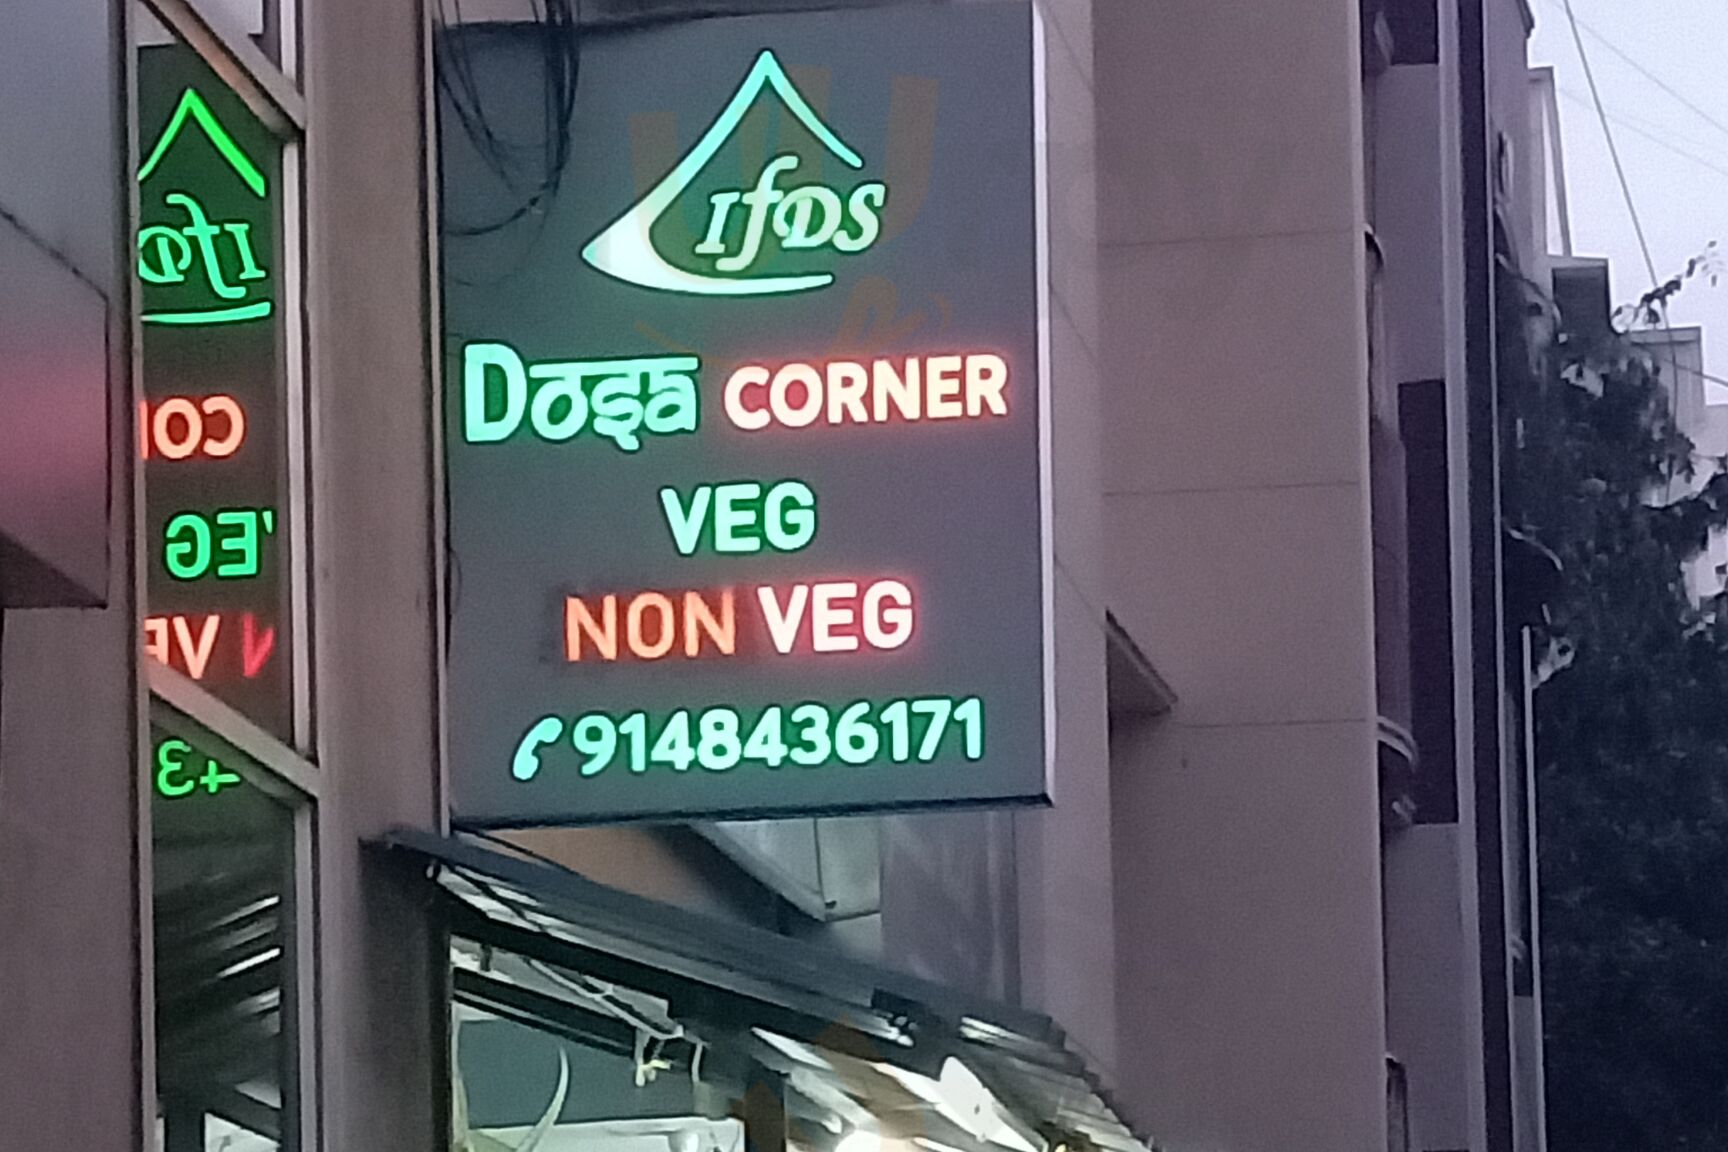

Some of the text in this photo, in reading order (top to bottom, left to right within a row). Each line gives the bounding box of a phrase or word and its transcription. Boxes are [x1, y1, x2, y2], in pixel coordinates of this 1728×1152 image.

[724, 354, 1007, 430] CORNER
[660, 481, 816, 555] VEG
[564, 580, 913, 662] NON VEG
[573, 697, 983, 776] 9148436171
